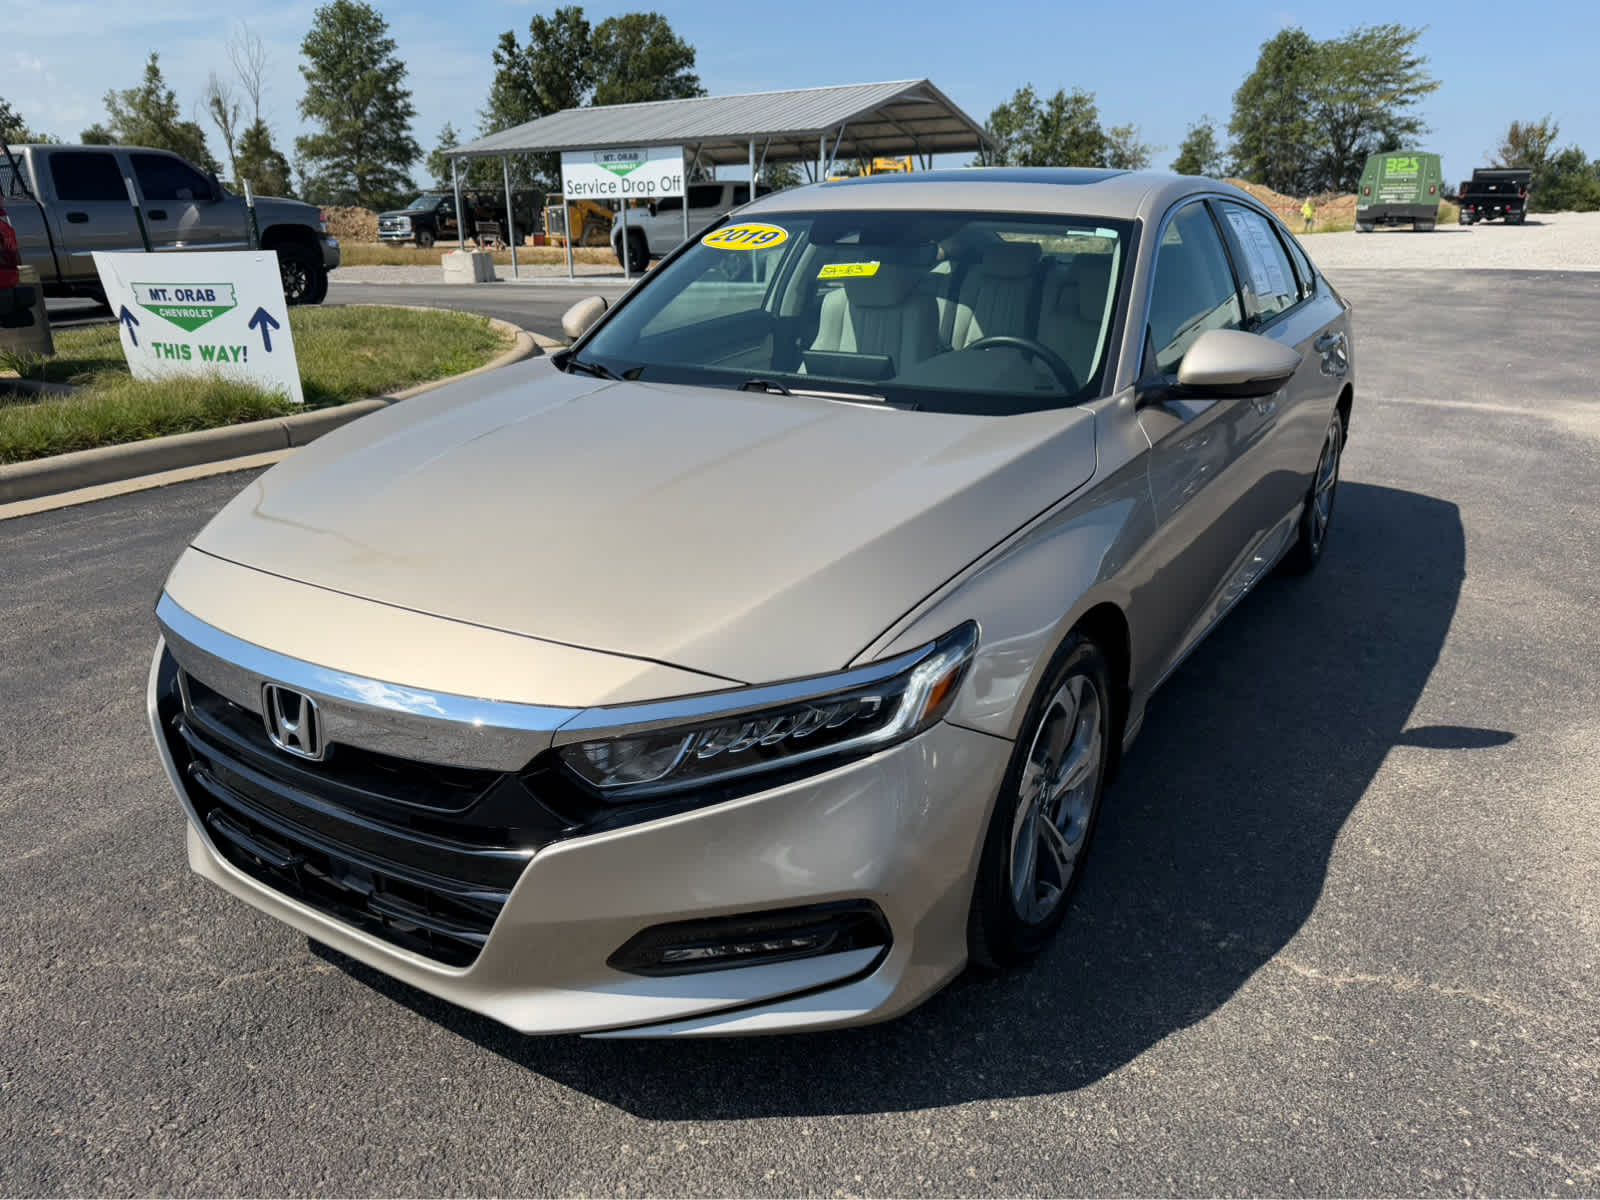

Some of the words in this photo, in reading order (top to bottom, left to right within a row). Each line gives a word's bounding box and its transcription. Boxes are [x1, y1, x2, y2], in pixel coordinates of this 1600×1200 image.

[567, 178, 617, 195] Service
[621, 178, 656, 195] Drop
[660, 175, 681, 192] Off
[709, 229, 779, 244] 2019
[149, 288, 172, 302] MT.
[175, 289, 216, 302] ORAB
[159, 308, 214, 318] CHEVROLET
[151, 342, 192, 361] THIS
[199, 345, 248, 363] WAY!
